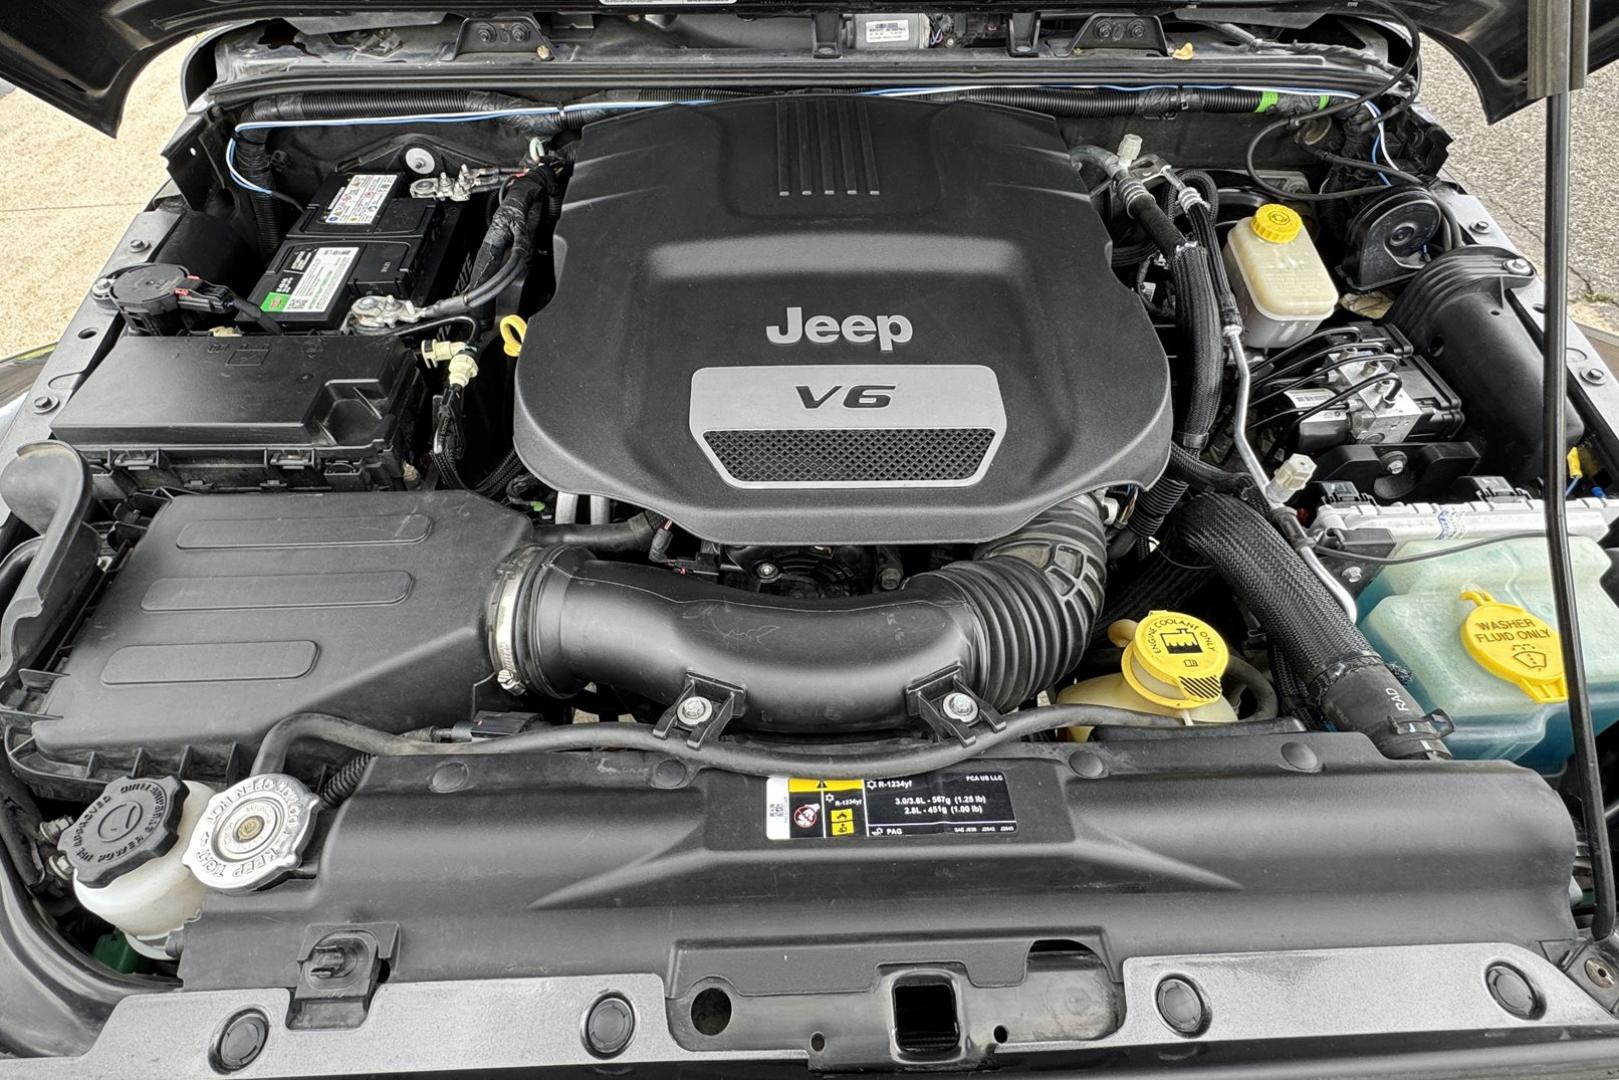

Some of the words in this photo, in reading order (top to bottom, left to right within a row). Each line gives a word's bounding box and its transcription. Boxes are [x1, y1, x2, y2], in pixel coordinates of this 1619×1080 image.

[766, 306, 914, 352] Jeep
[795, 385, 897, 409] V6
[1154, 618, 1200, 631] COOLANT
[1475, 618, 1536, 631] WASHER
[1147, 627, 1162, 655] ENGINE
[1199, 631, 1216, 652] ONLY
[1474, 632, 1516, 643] FLUID
[1516, 628, 1551, 640] ONLY
[1385, 687, 1409, 712] RAD
[878, 780, 912, 789] R-1234yf
[895, 797, 926, 805] 3.0/3.6L
[954, 795, 974, 804] (1.25
[928, 805, 948, 814] 451g
[950, 805, 970, 814] (1.00
[232, 846, 280, 878] KEEP
